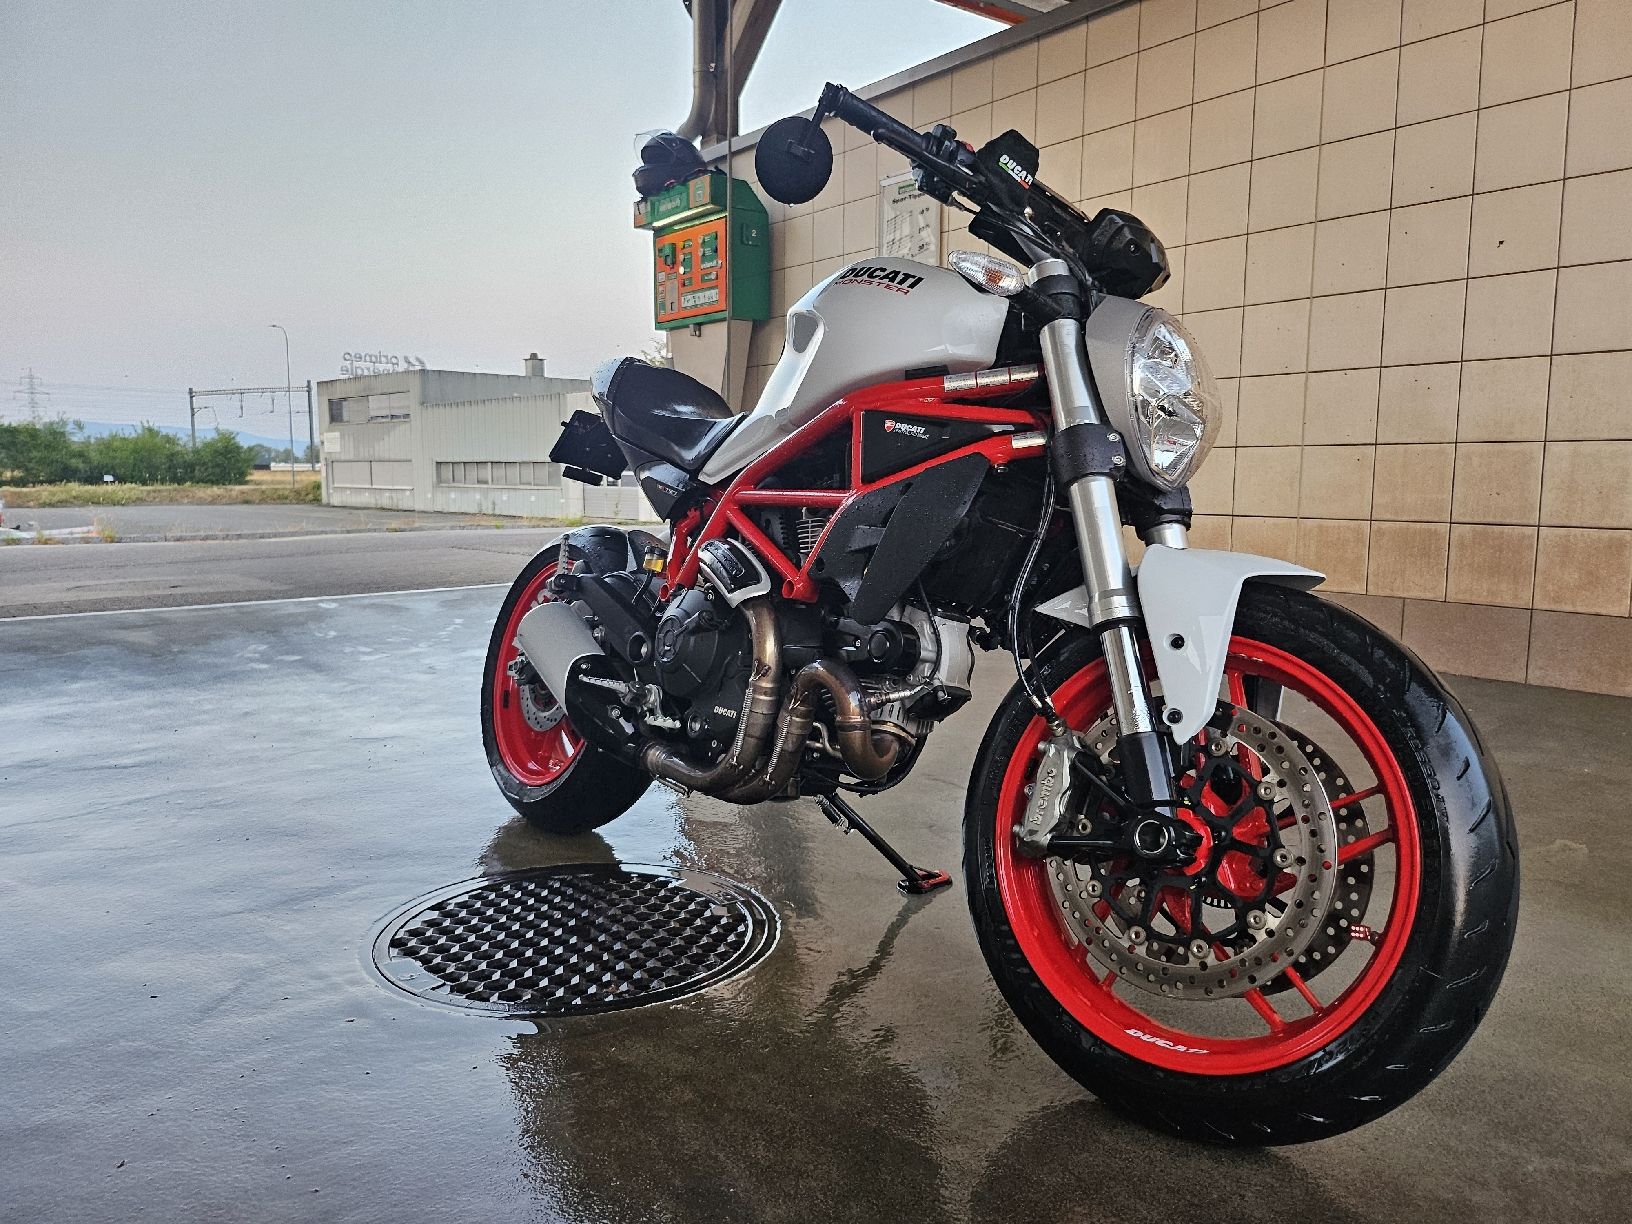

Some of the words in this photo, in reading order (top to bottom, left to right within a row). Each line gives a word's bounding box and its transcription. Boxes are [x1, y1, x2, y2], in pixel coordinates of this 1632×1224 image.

[999, 154, 1034, 186] DUCATI
[751, 229, 758, 237] 2
[833, 278, 911, 296] MONSTER
[839, 266, 925, 290] DUCATI
[894, 422, 926, 434] DUCATI
[713, 705, 738, 719] DUCATI
[1029, 767, 1058, 826] brembo
[1123, 1028, 1210, 1055] DUCATI
